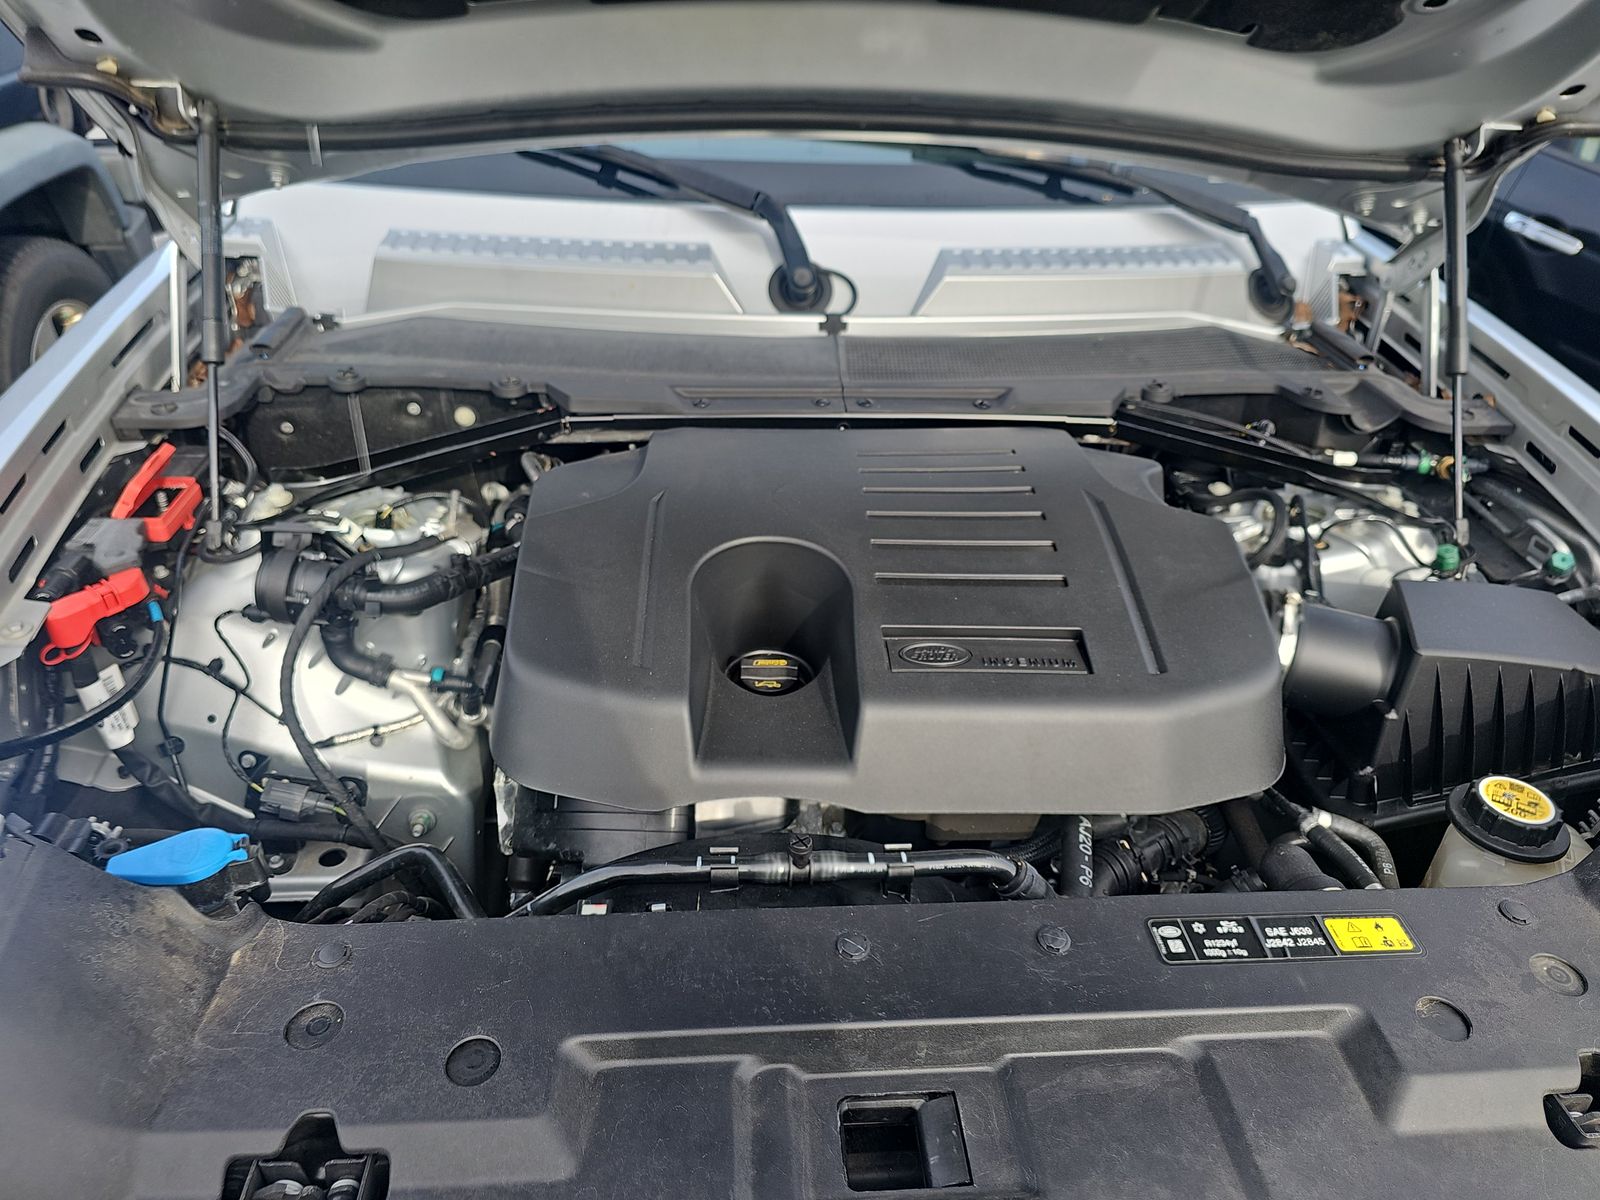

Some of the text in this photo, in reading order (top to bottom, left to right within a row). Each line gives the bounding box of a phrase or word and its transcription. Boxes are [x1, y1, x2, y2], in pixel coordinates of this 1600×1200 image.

[981, 656, 1077, 668] INGENIUM
[1265, 926, 1313, 937] SAE J639
[1296, 937, 1326, 947] J2845
